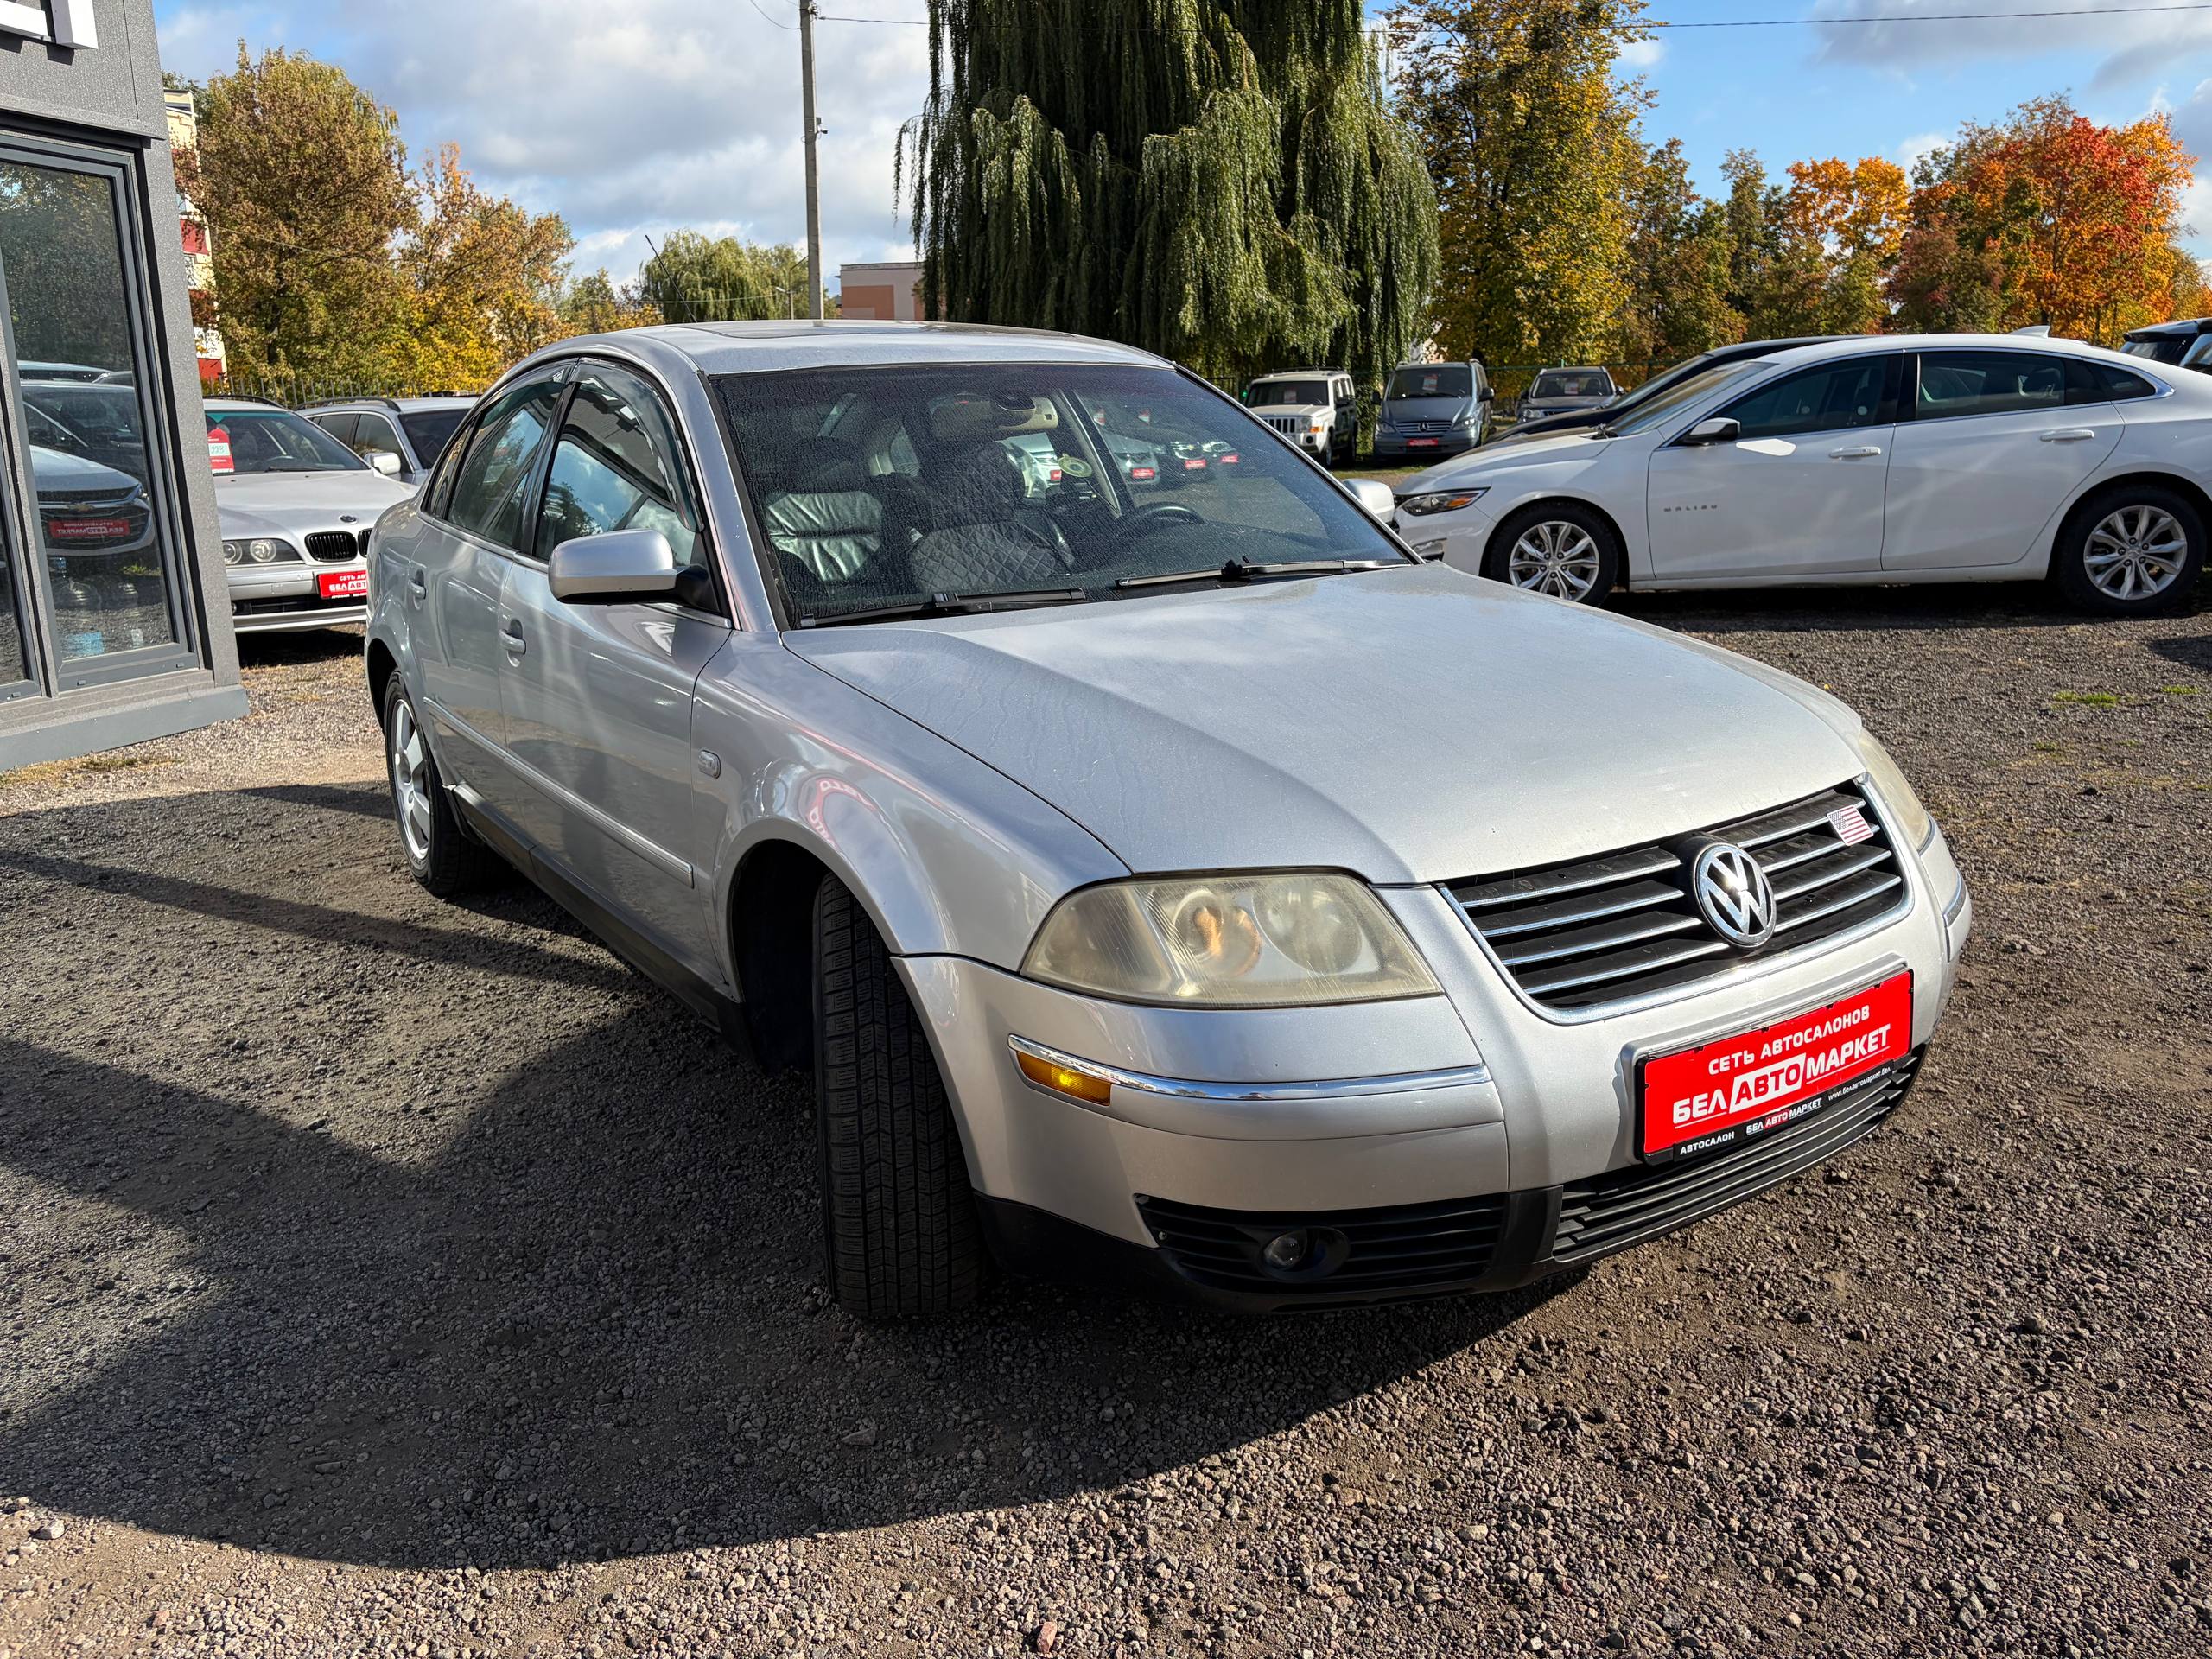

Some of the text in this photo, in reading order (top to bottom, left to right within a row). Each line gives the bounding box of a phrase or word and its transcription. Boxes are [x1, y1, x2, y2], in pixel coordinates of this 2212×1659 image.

[1708, 1005, 1870, 1075] СЕТЬ АВТОСАЛОНОВ
[1680, 1131, 1735, 1155] АВТОСАЛОН
